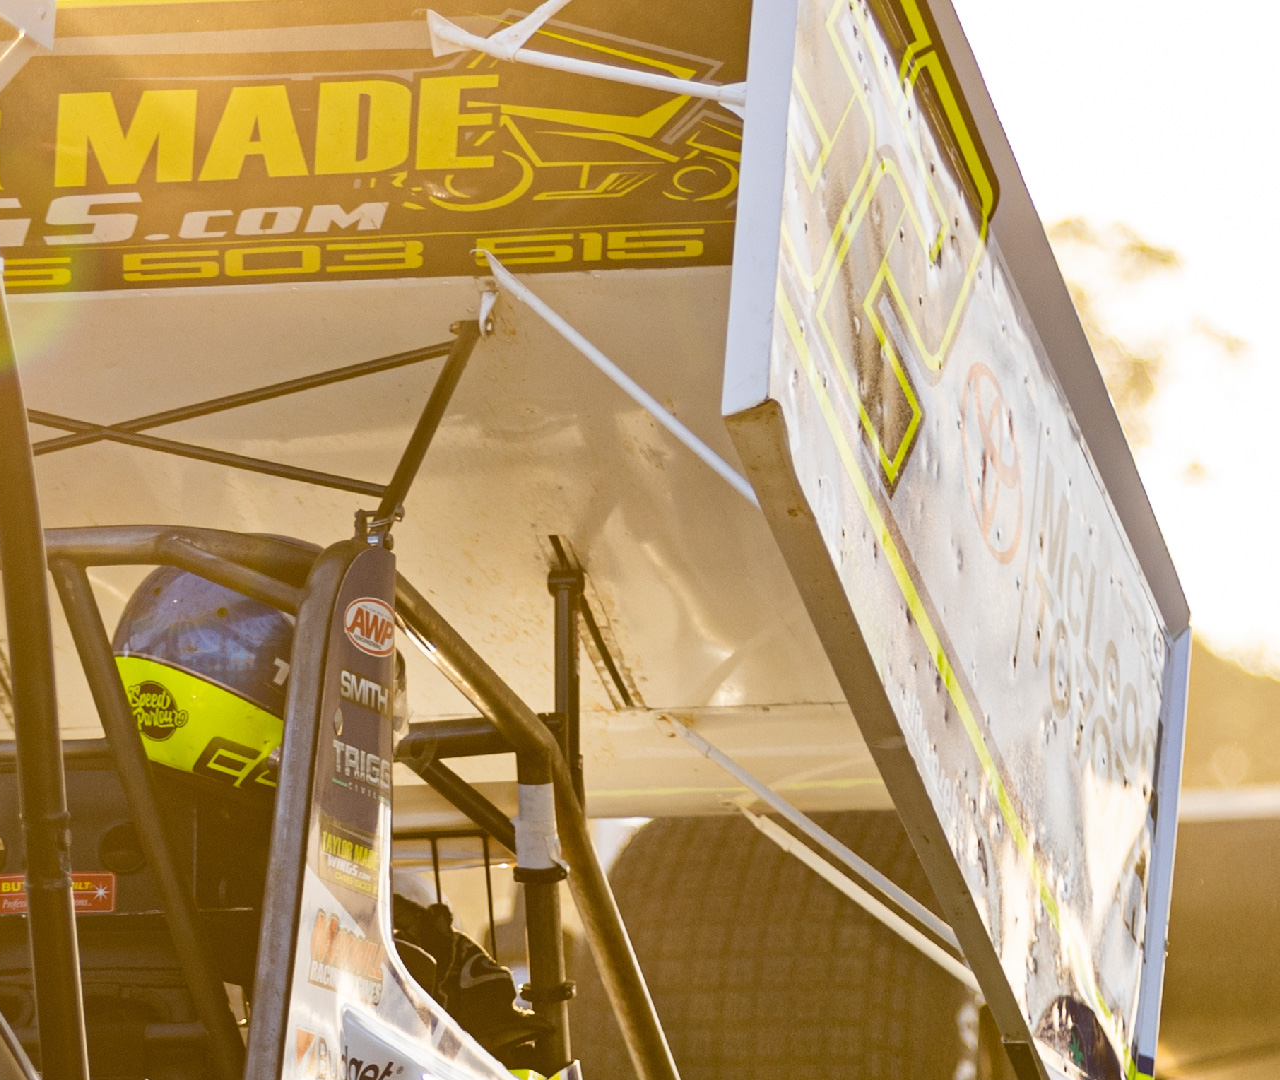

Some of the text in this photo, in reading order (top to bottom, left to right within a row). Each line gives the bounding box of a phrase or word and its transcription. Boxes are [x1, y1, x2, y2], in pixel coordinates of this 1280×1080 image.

[54, 75, 499, 187] MADE
[123, 240, 424, 282] 503
[475, 228, 705, 267] 515
[347, 606, 393, 645] AWP
[341, 670, 389, 714] SMITH
[332, 739, 391, 790] TRIGG
